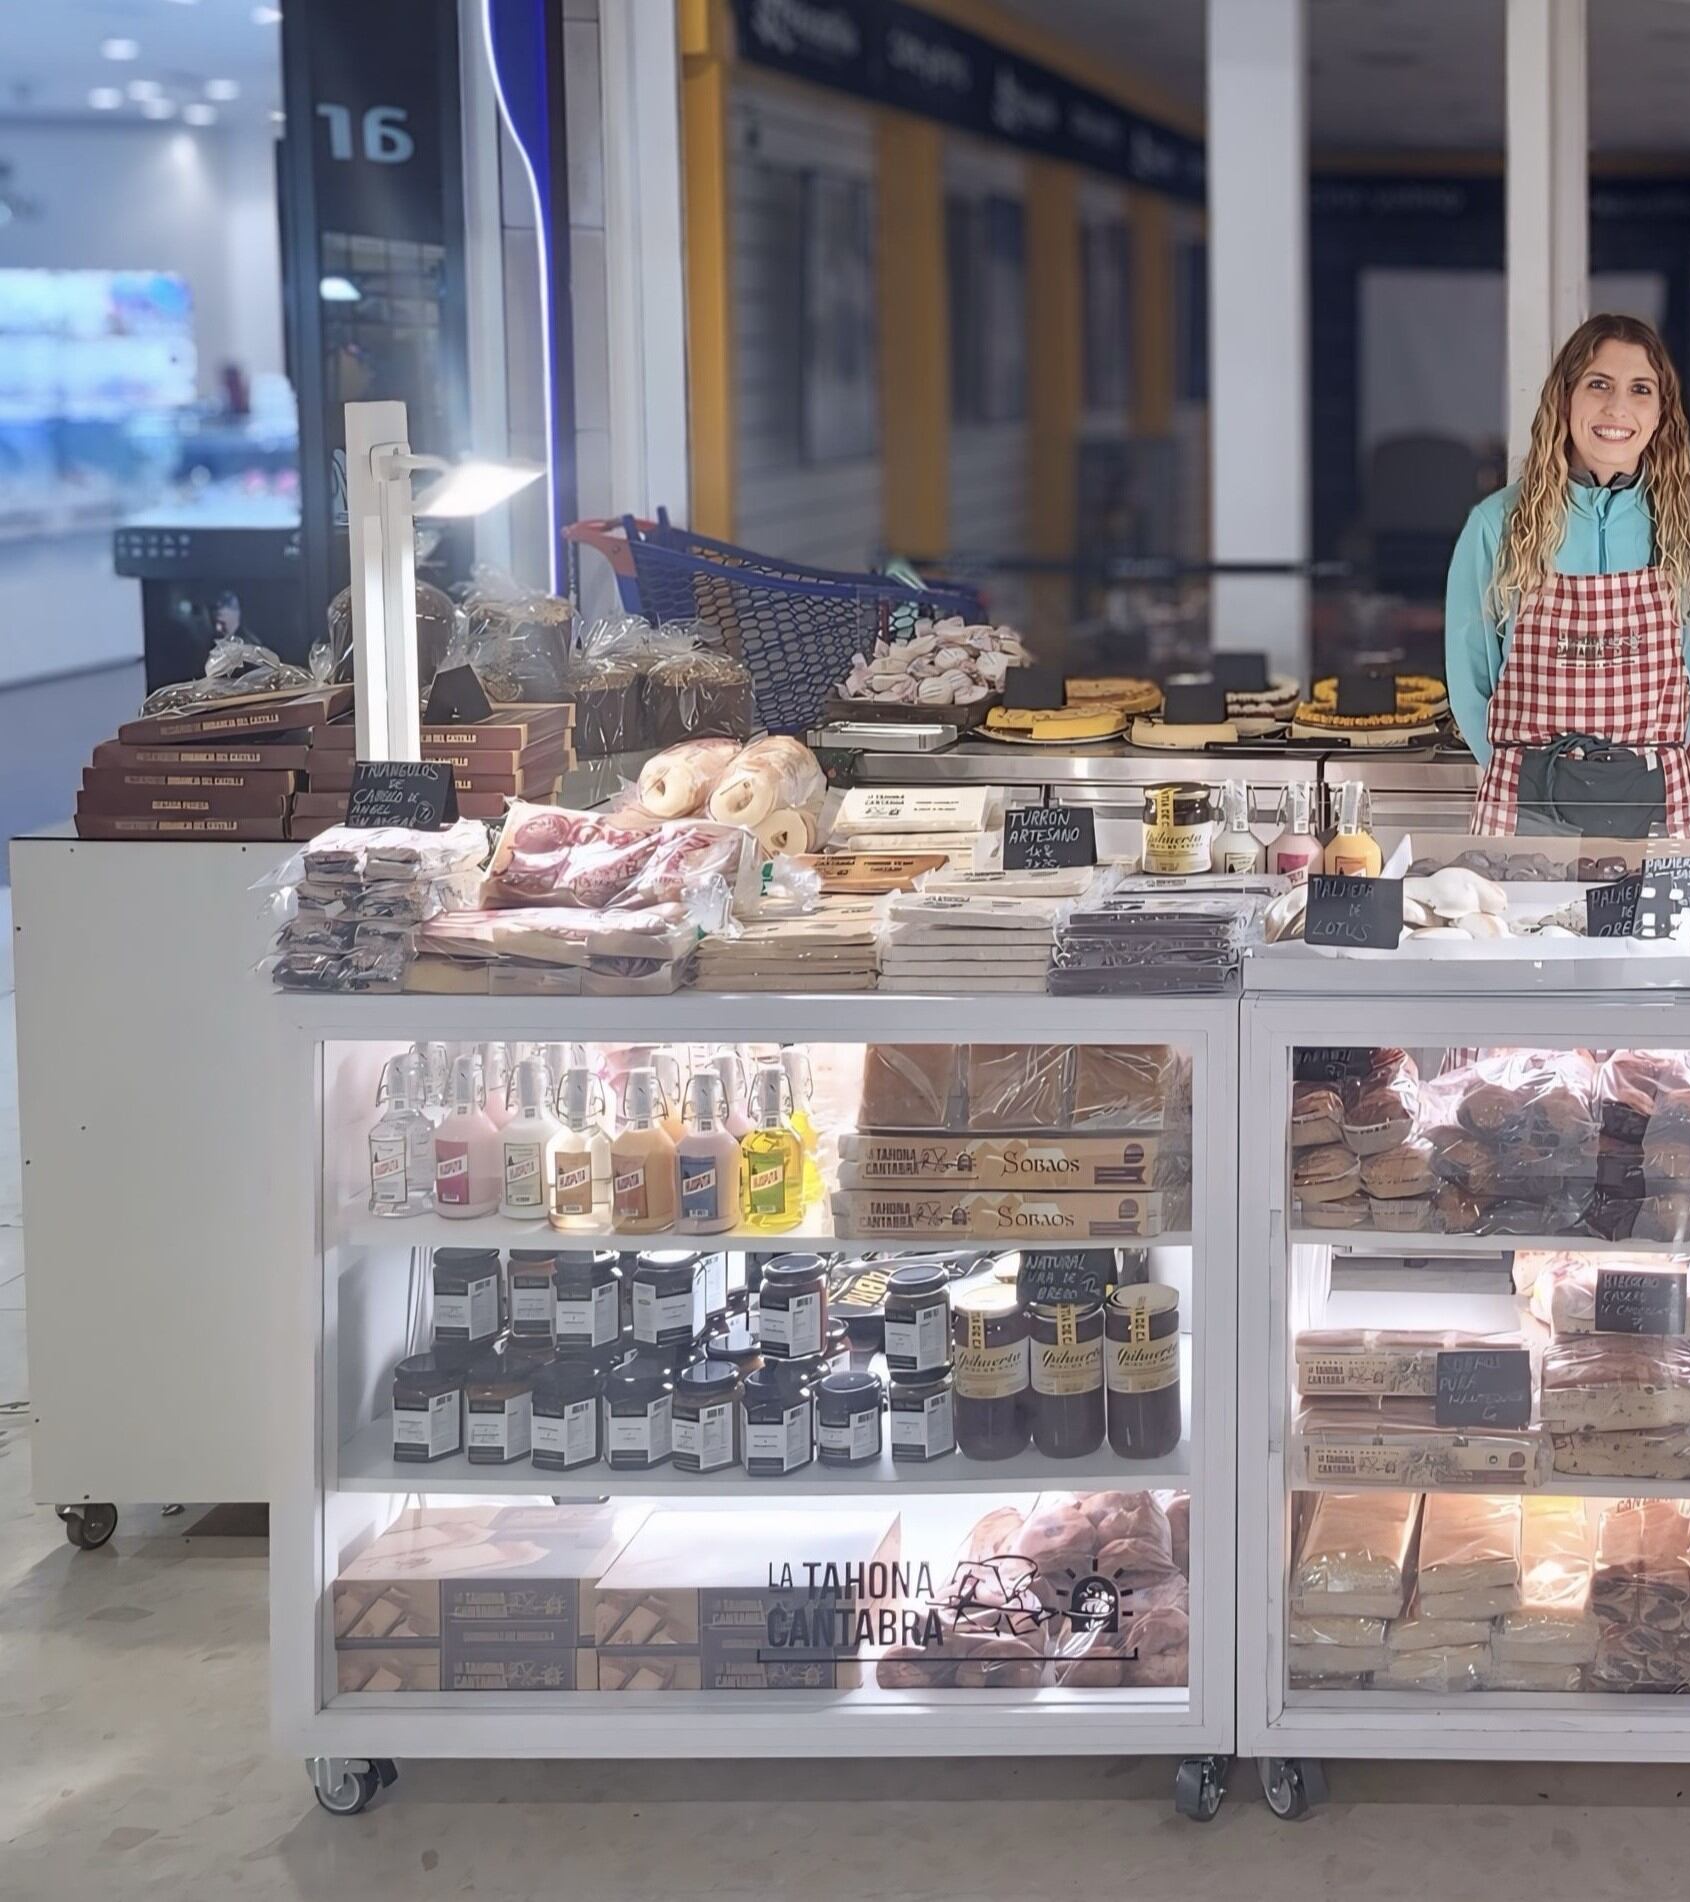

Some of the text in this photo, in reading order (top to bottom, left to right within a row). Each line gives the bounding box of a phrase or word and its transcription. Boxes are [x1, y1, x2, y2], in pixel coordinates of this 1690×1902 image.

[1008, 827, 1080, 844] ARTESANO
[1312, 920, 1373, 942] LOTUS
[1025, 1253, 1086, 1271] NATURAL
[768, 1561, 935, 1599] LA TAHONA
[767, 1608, 944, 1647] CANTABRA
